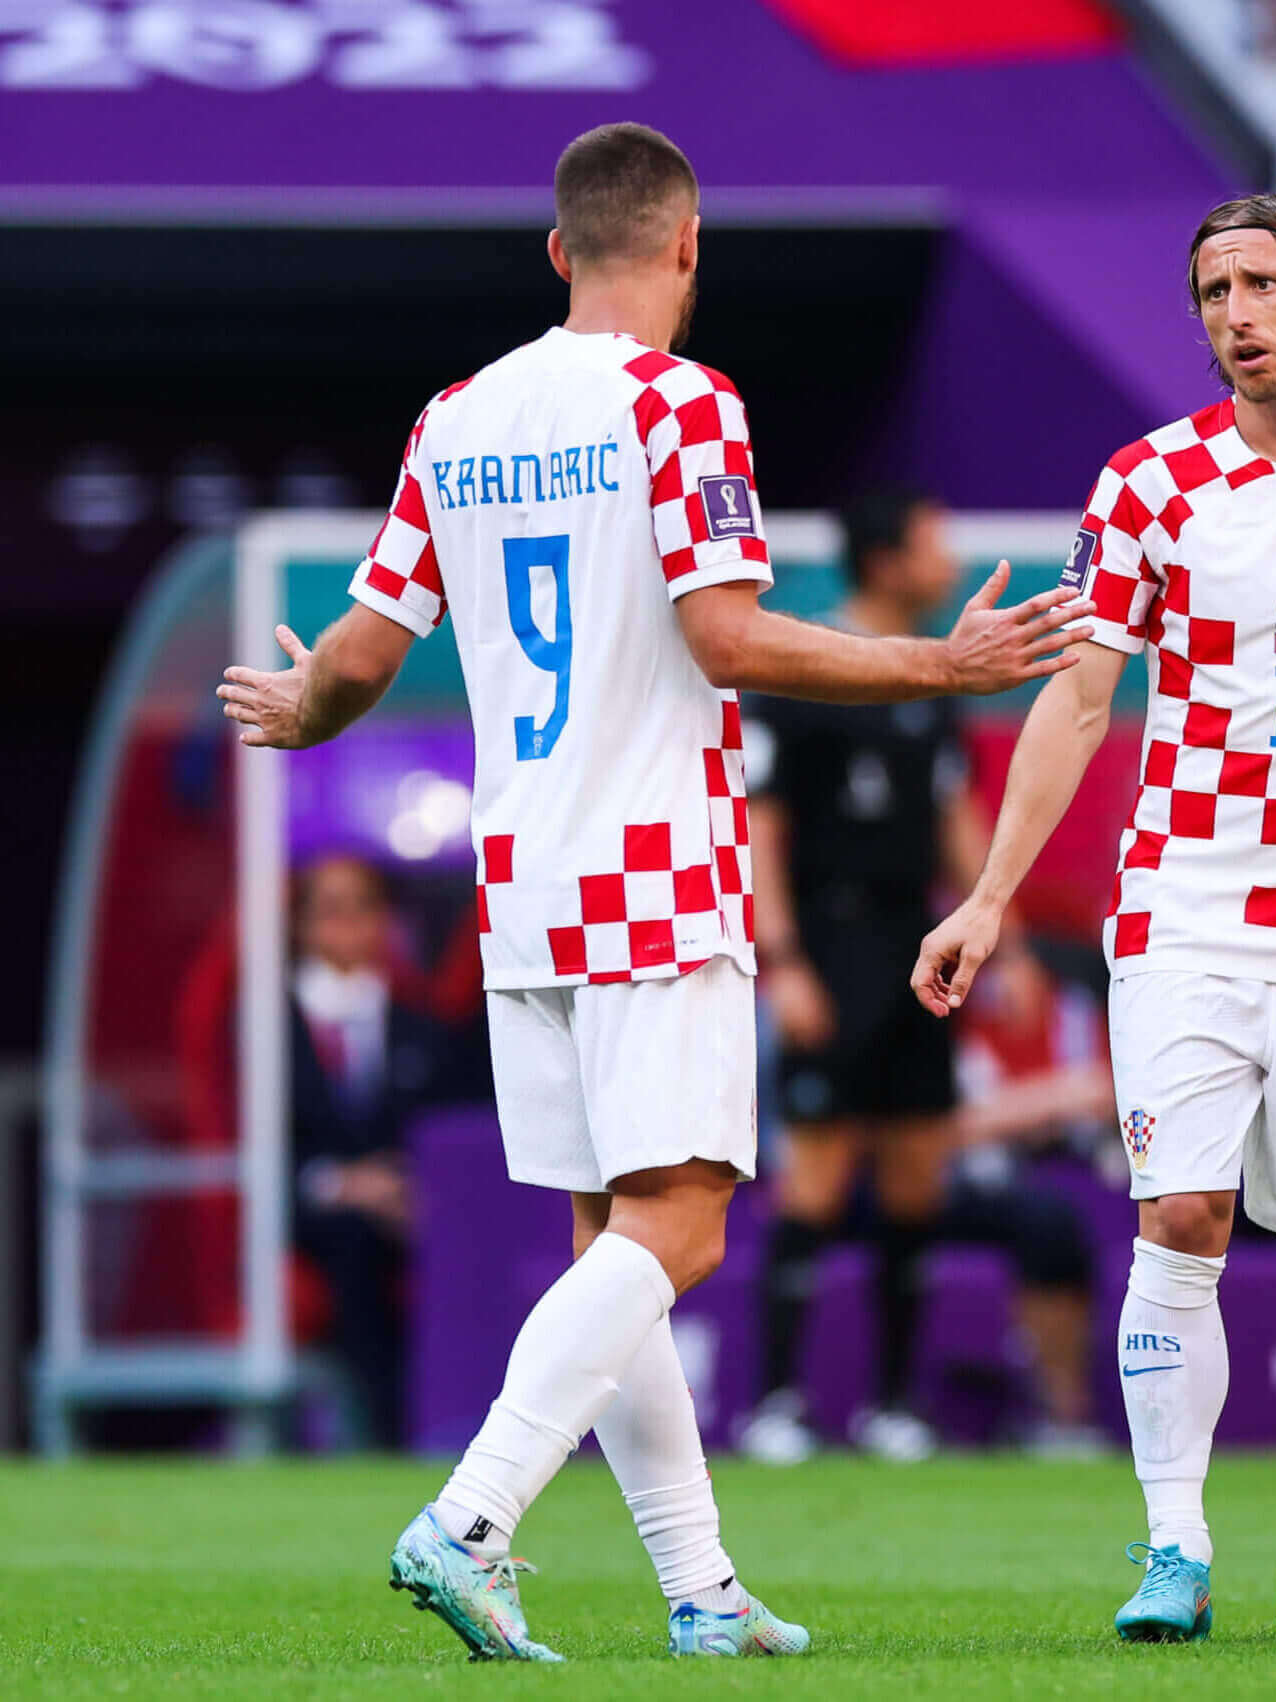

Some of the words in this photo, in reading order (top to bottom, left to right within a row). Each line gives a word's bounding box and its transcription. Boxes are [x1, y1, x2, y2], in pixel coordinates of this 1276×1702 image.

[432, 433, 619, 510] KRAMARIĆ
[502, 534, 573, 762] 9
[1126, 1333, 1181, 1352] HNS
